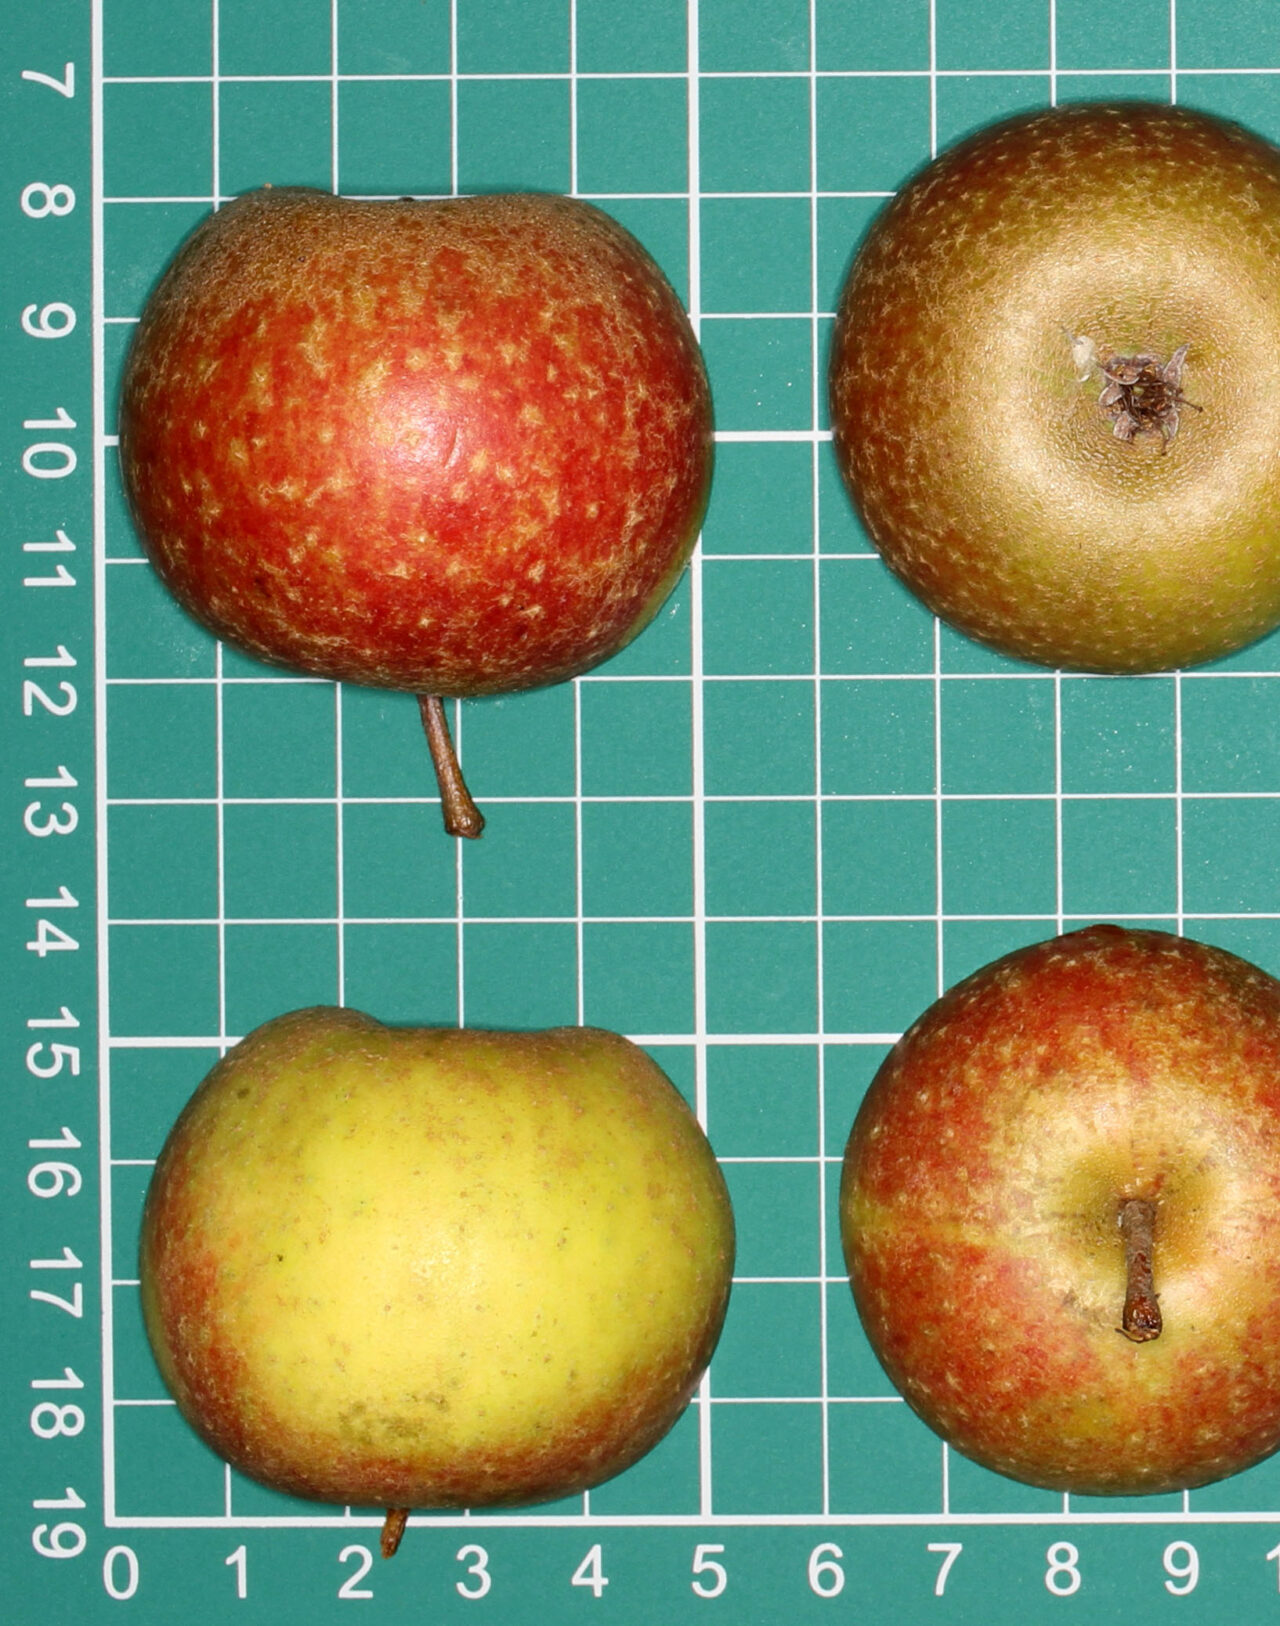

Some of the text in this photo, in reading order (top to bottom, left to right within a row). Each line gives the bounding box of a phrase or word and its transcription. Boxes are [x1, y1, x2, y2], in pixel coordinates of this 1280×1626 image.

[20, 61, 88, 1559] 7 8 9 10 11 12 13 14 15 16 17 18 19
[102, 1544, 140, 1601] 0
[224, 1544, 248, 1600] 1
[337, 1543, 375, 1600] 2
[455, 1543, 493, 1600] 3
[570, 1543, 610, 1599] 4
[690, 1543, 728, 1599] 5
[807, 1541, 847, 1599] 6
[926, 1541, 964, 1597] 7
[1042, 1540, 1083, 1597] 8
[1162, 1539, 1201, 1598] 9
